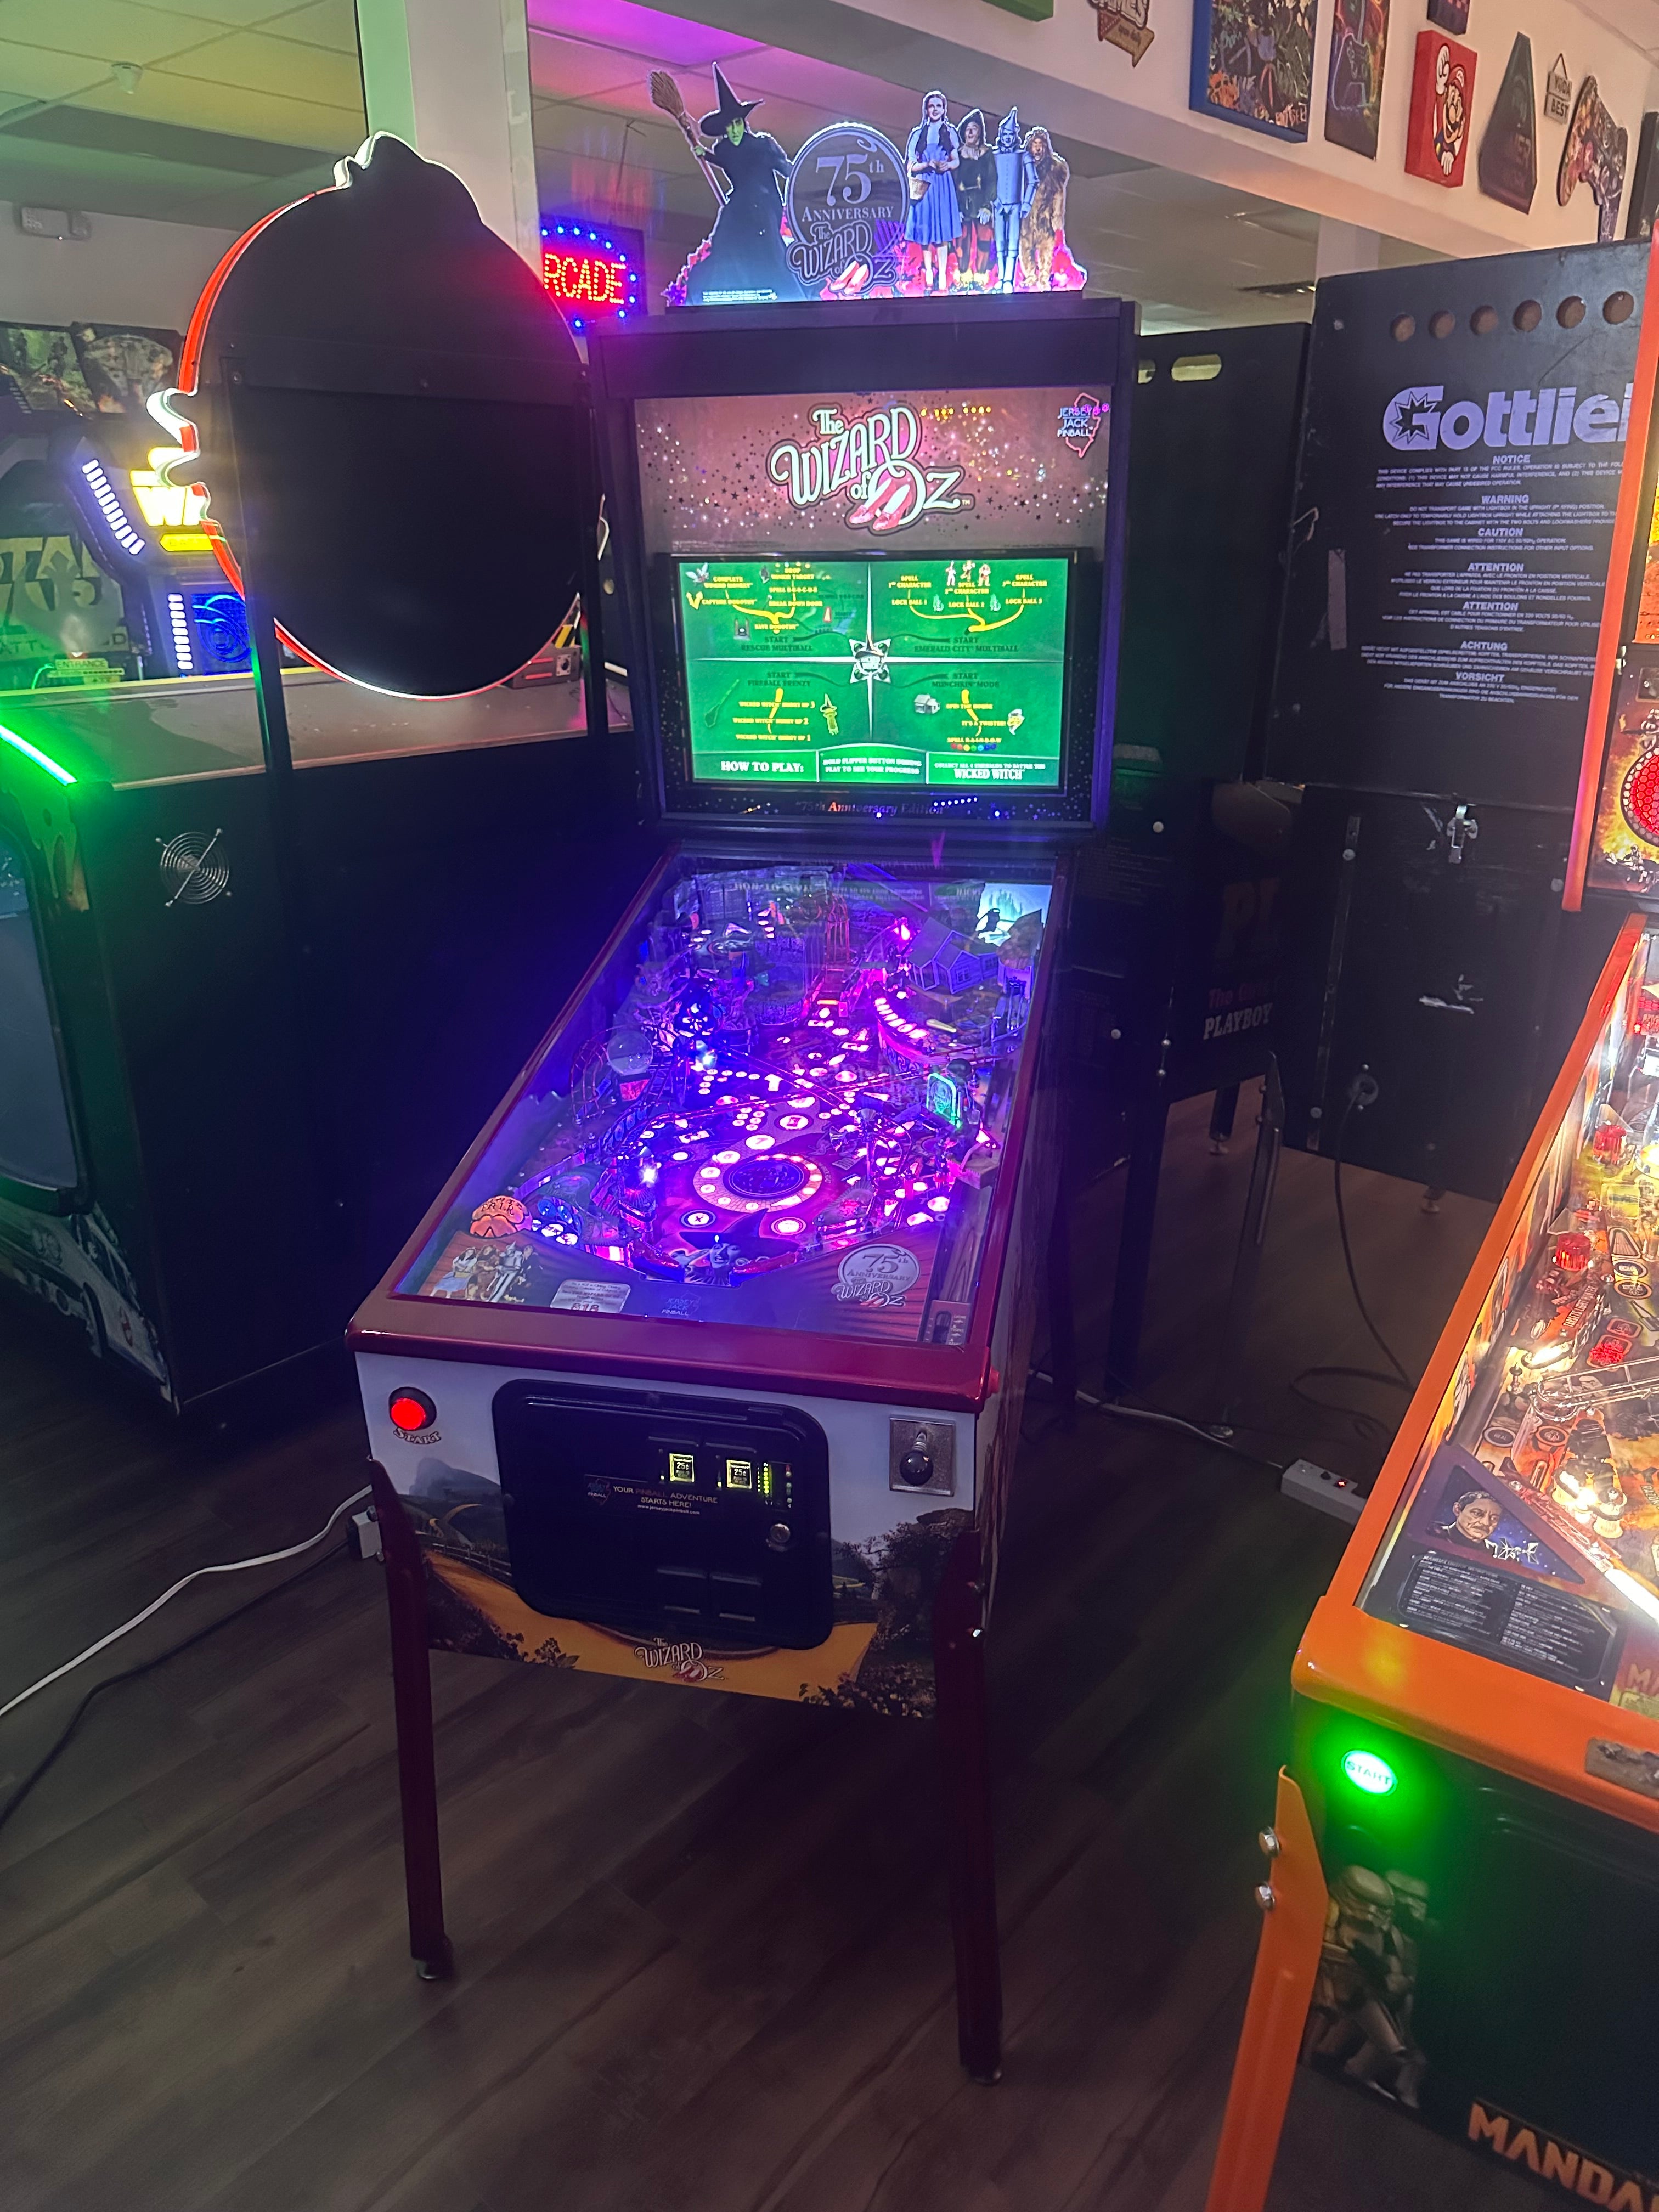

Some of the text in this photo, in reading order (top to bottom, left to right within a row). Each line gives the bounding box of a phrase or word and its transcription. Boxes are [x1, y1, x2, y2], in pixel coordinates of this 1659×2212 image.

[1551, 99, 1569, 118] BEST
[802, 206, 894, 222] ANNIVERSARY
[792, 223, 868, 278] WIZARD
[1057, 407, 1092, 419] JERSEY
[812, 409, 844, 435] The
[1062, 418, 1088, 430] JACK
[1057, 428, 1091, 438] PINBALL
[771, 407, 917, 505] WIZARD
[1493, 454, 1531, 464] NOTICE
[850, 471, 872, 499] of
[1482, 494, 1529, 504] WARNING
[1478, 527, 1523, 537] CAUTION
[1468, 562, 1524, 572] ATTENTION
[1463, 601, 1519, 611] ATTENTION
[1460, 641, 1507, 651] ACHTUNG
[57, 659, 107, 668] ENTRANCE
[1455, 672, 1505, 682] VORSICHT
[721, 761, 804, 773] HOW TO PLAY:
[954, 768, 990, 780] WICKED
[828, 801, 898, 817] Anniversary
[1204, 1002, 1273, 1040] PLAYBOY
[847, 1268, 913, 1281] ANNIVERSARY
[836, 1281, 891, 1299] WIZARD
[571, 1302, 600, 1312] 818
[393, 1427, 441, 1444] START
[1493, 1432, 1507, 1441] HEAL
[613, 1486, 634, 1494] YOUR
[670, 1493, 718, 1504] ADVENTURE
[641, 1497, 692, 1508] STARTS HERE!
[635, 1642, 702, 1668] WIZARD
[1347, 1760, 1391, 1785] START
